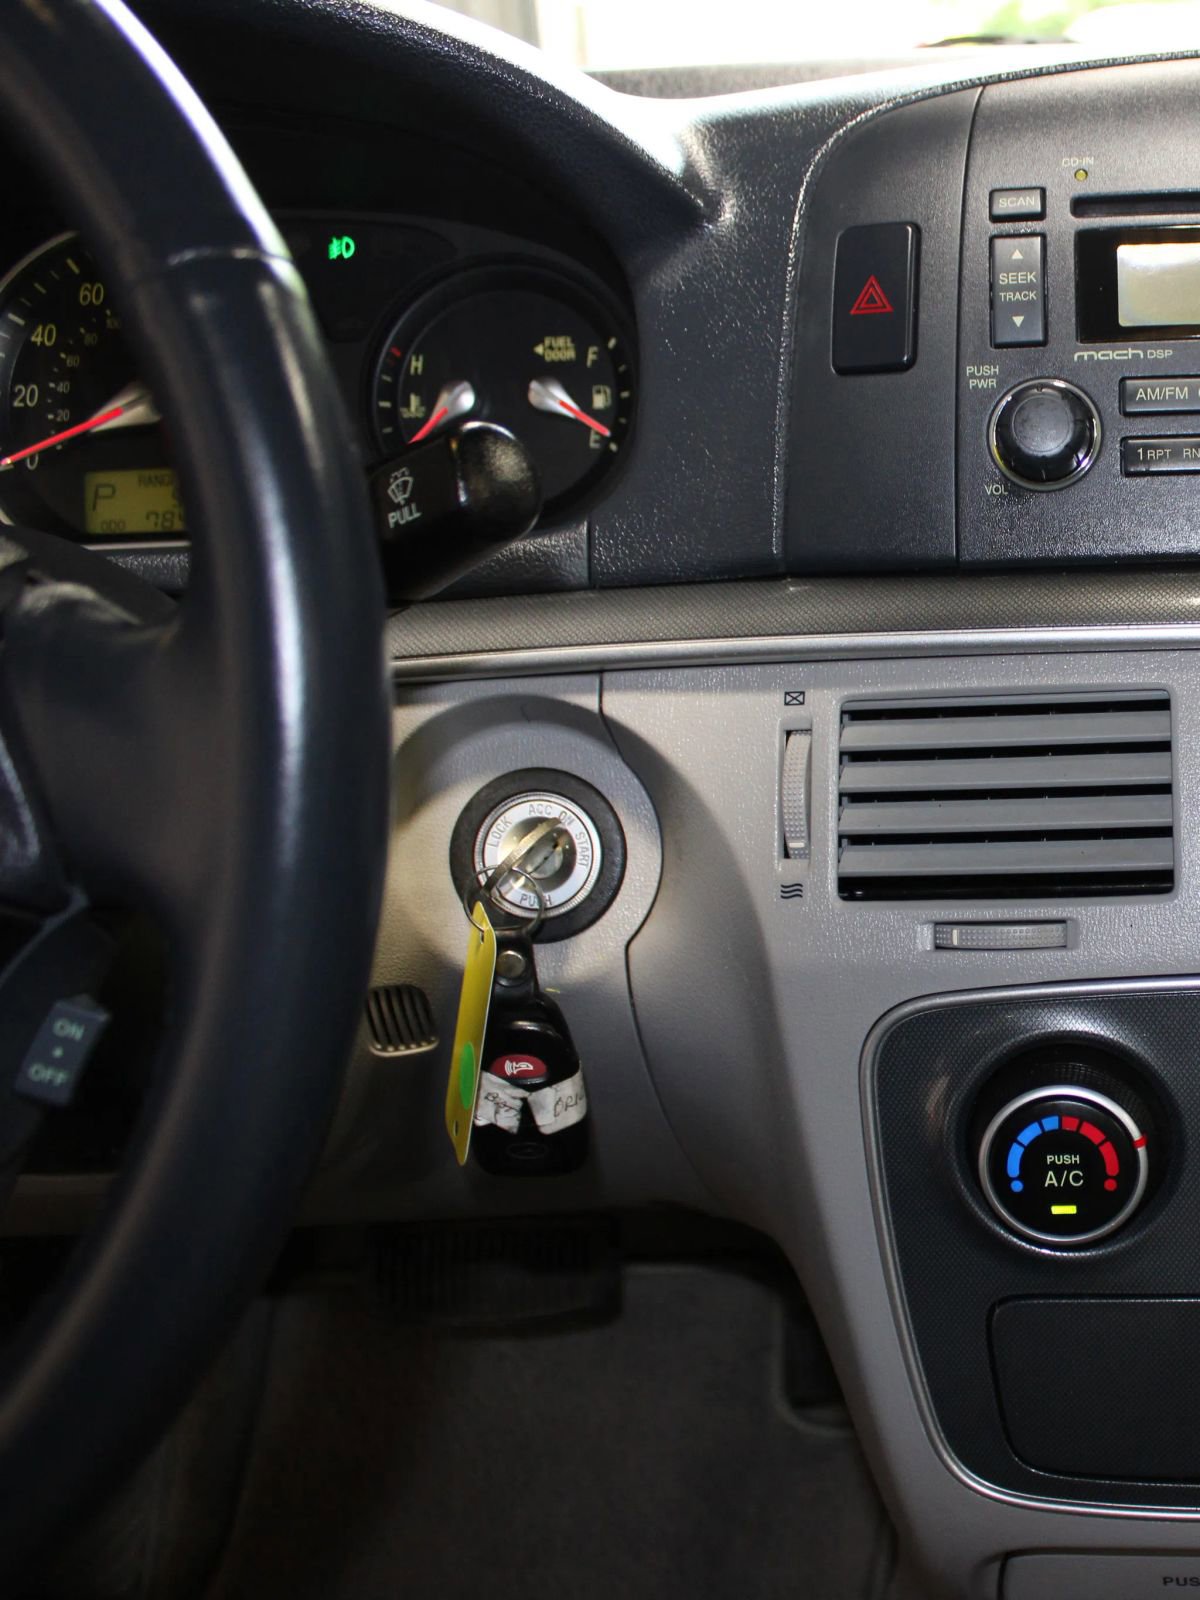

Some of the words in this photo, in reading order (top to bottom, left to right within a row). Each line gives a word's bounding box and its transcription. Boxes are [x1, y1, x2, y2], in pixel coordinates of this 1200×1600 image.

[1062, 156, 1095, 168] CD-IN
[999, 196, 1035, 208] SCAN
[999, 271, 1036, 285] SEEK
[79, 283, 104, 305] 60
[999, 290, 1037, 302] TRACK
[31, 324, 56, 347] 40
[544, 336, 573, 348] FUEL
[544, 349, 576, 362] DOOR
[586, 347, 598, 367] F
[1073, 347, 1144, 361] mach
[1147, 349, 1173, 359] DSP
[410, 355, 424, 375] H
[966, 365, 999, 378] PUSH
[969, 378, 997, 390] PWR
[13, 384, 38, 408] 20
[1136, 386, 1189, 401] AM/FM
[56, 410, 70, 422] 20
[1137, 448, 1144, 461] 1
[1148, 449, 1172, 460] RPT
[138, 473, 173, 487] RANG
[984, 484, 1008, 495] VOL
[92, 483, 116, 512] P
[388, 504, 422, 529] PULL
[528, 803, 553, 816] ACC
[558, 810, 574, 826] ON
[487, 815, 513, 849] LOCK
[575, 831, 589, 867] START
[519, 893, 552, 906] PUH
[52, 1018, 84, 1041] ON
[29, 1063, 69, 1087] OFF
[1046, 1155, 1080, 1165] PUSH
[1044, 1170, 1084, 1187] A/C
